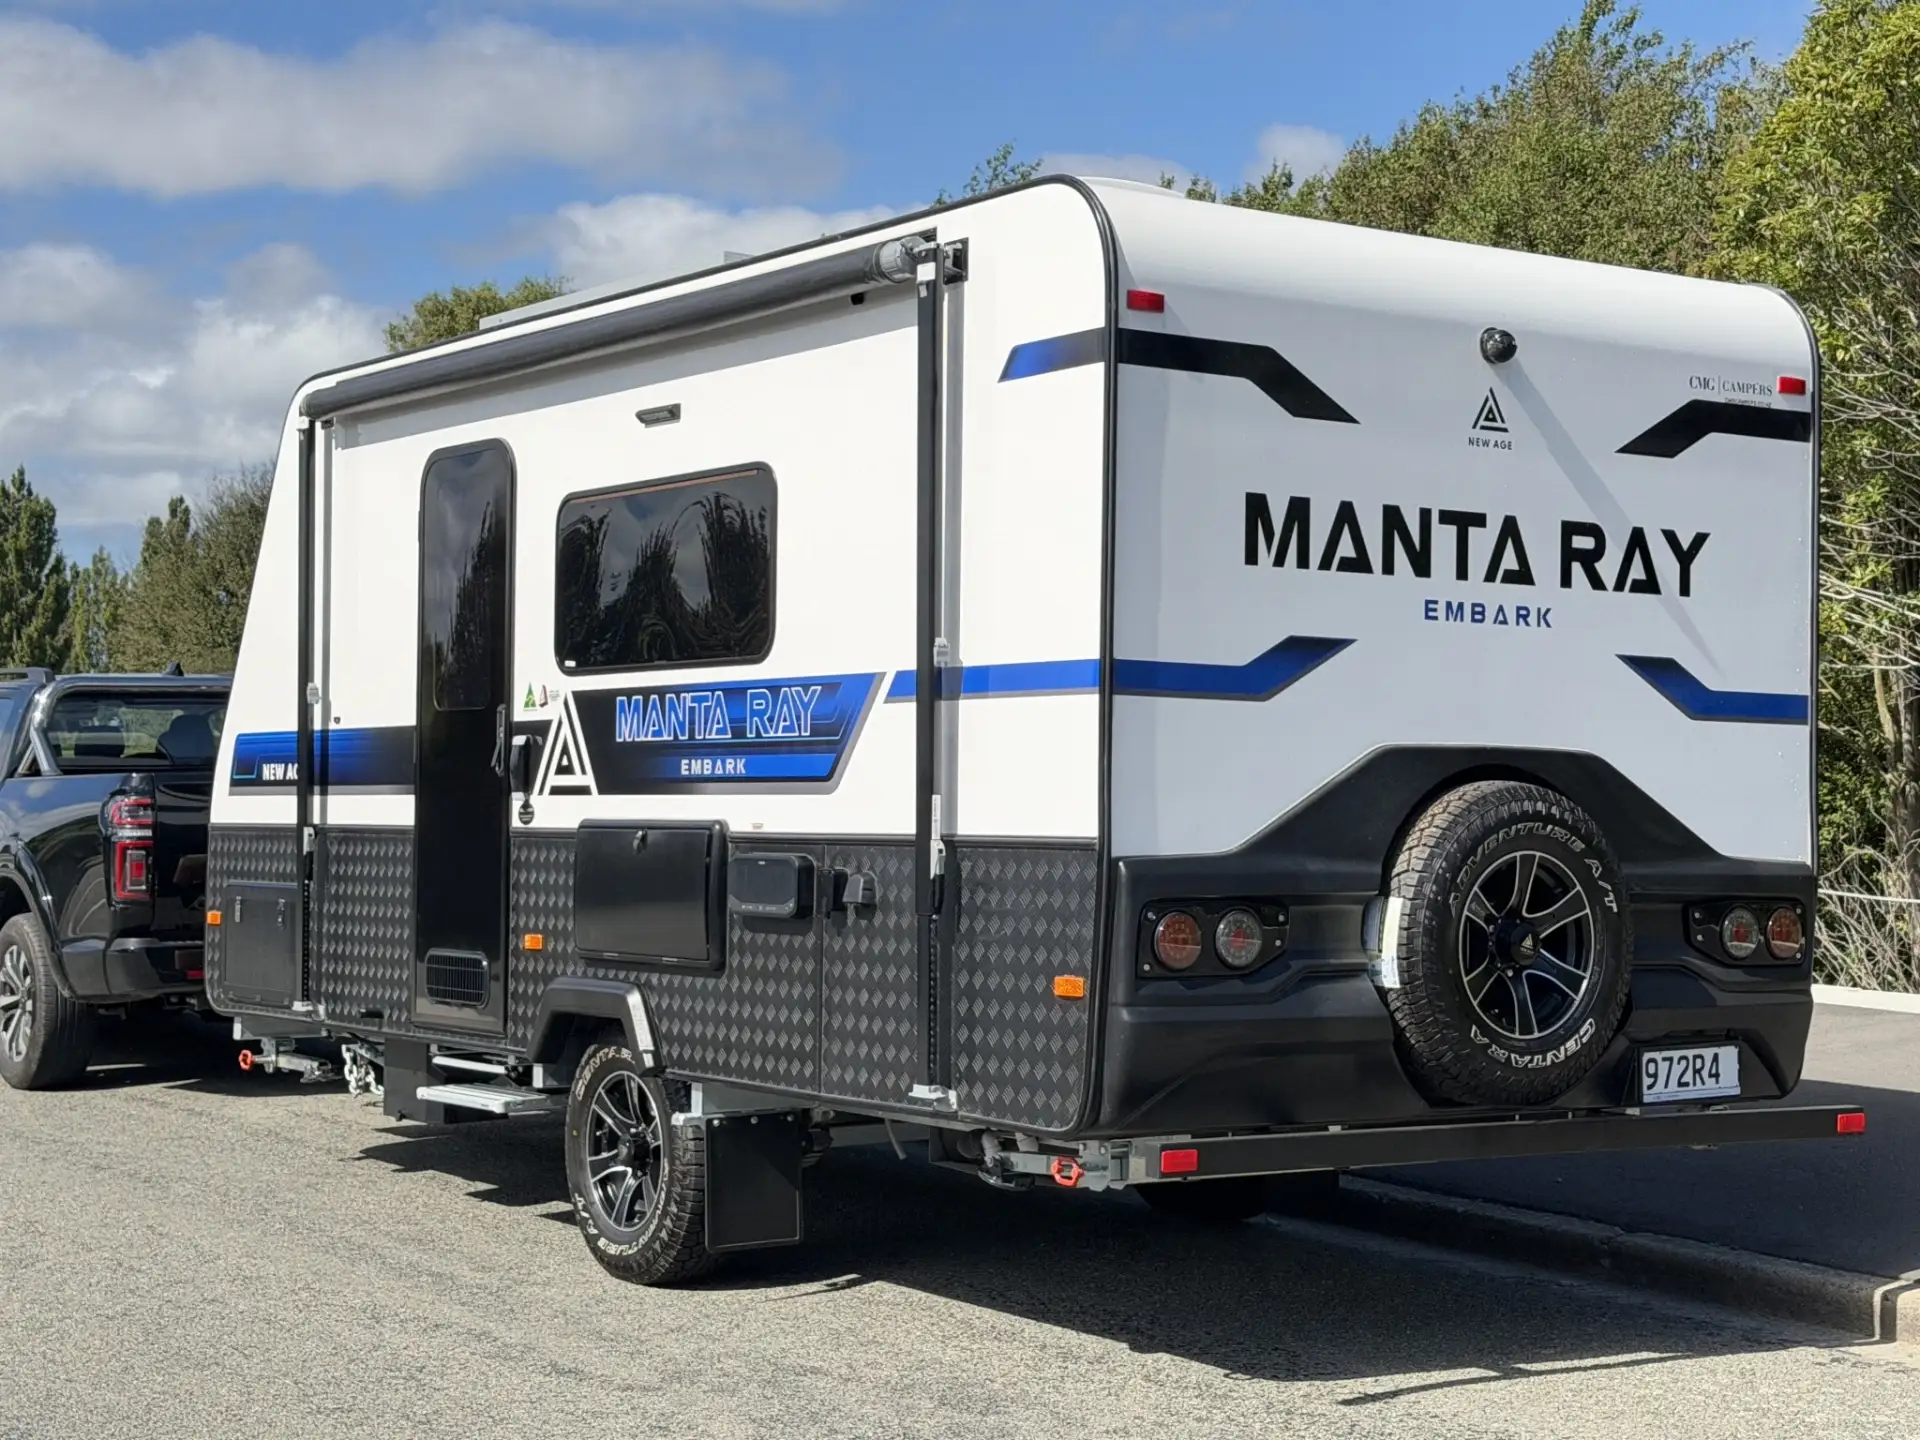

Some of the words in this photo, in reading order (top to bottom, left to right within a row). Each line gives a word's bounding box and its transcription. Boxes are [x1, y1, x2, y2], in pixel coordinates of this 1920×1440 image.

[1689, 375, 1716, 391] CMG
[1722, 380, 1773, 397] CAMPERS
[1468, 436, 1491, 448] NEW
[1493, 439, 1512, 451] AGE
[1244, 492, 1536, 586] MANTA
[1560, 520, 1711, 597] RAY
[1424, 599, 1553, 629] EMBARK
[615, 690, 732, 743] MANTA
[746, 685, 821, 738] RAY
[262, 763, 285, 781] NEW
[680, 758, 747, 776] EMBARK
[1449, 822, 1586, 918] ADVENTURE
[1470, 1018, 1596, 1068] CENTARA
[575, 1046, 636, 1102] CENTAR
[1645, 1052, 1721, 1091] 972R4
